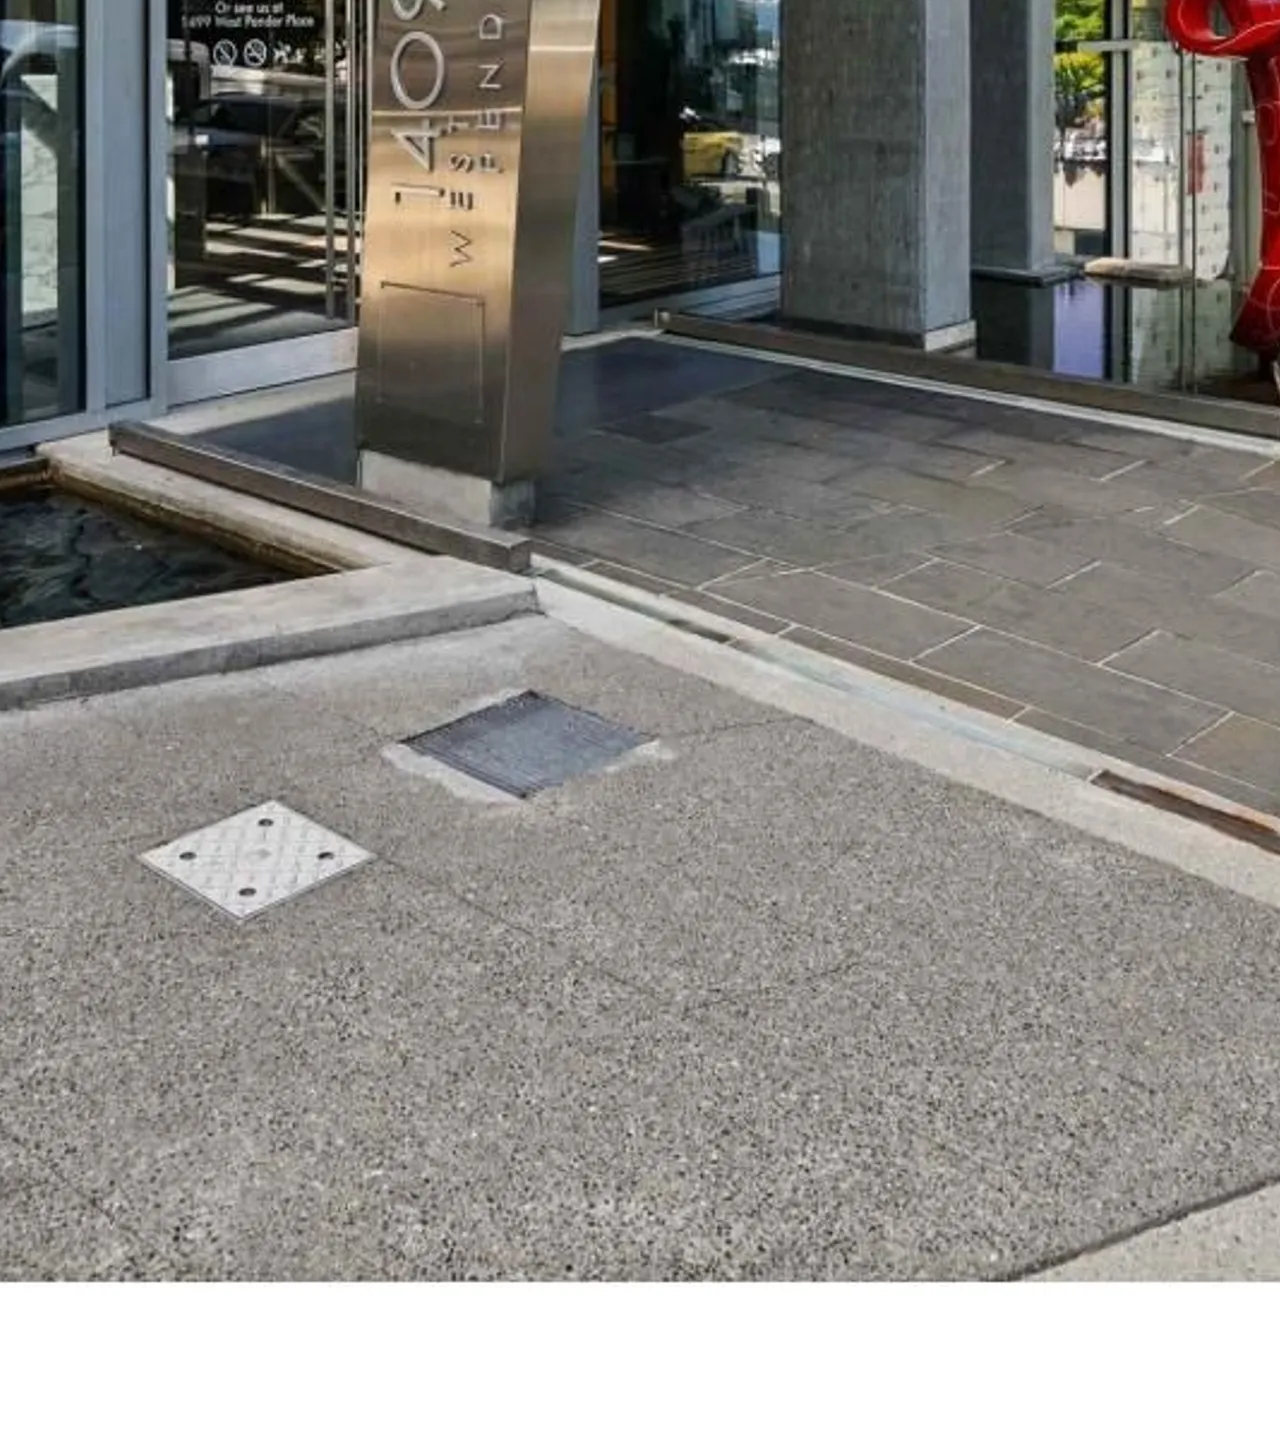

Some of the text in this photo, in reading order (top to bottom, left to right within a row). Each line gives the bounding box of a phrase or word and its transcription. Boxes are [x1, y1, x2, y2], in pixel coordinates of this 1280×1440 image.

[215, 1, 284, 15] Or see us at
[215, 16, 242, 28] West
[244, 14, 282, 29] Pender
[285, 14, 315, 28] Place
[447, 115, 474, 268] WEST
